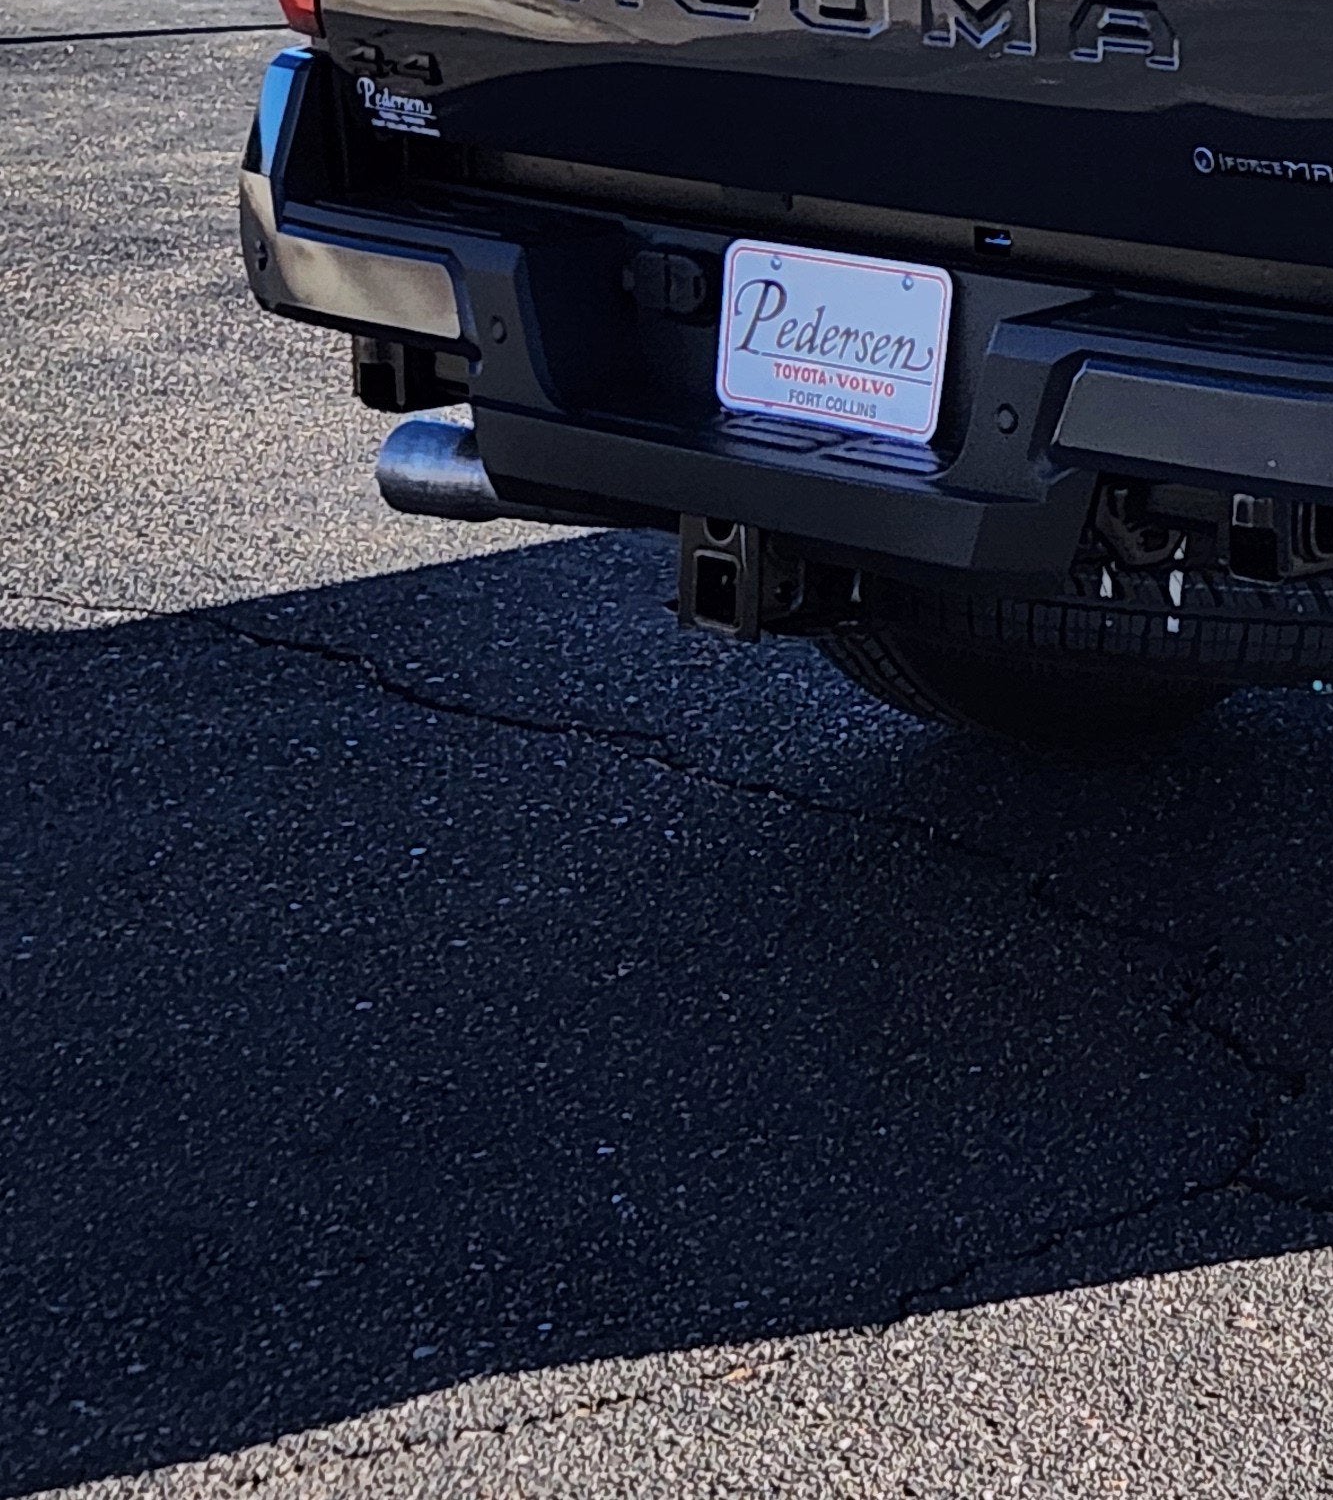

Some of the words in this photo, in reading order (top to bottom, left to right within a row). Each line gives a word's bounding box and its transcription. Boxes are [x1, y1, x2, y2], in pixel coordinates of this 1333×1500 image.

[734, 278, 934, 372] Pedersen
[789, 388, 823, 409] FORT
[825, 395, 877, 420] COLLINS
